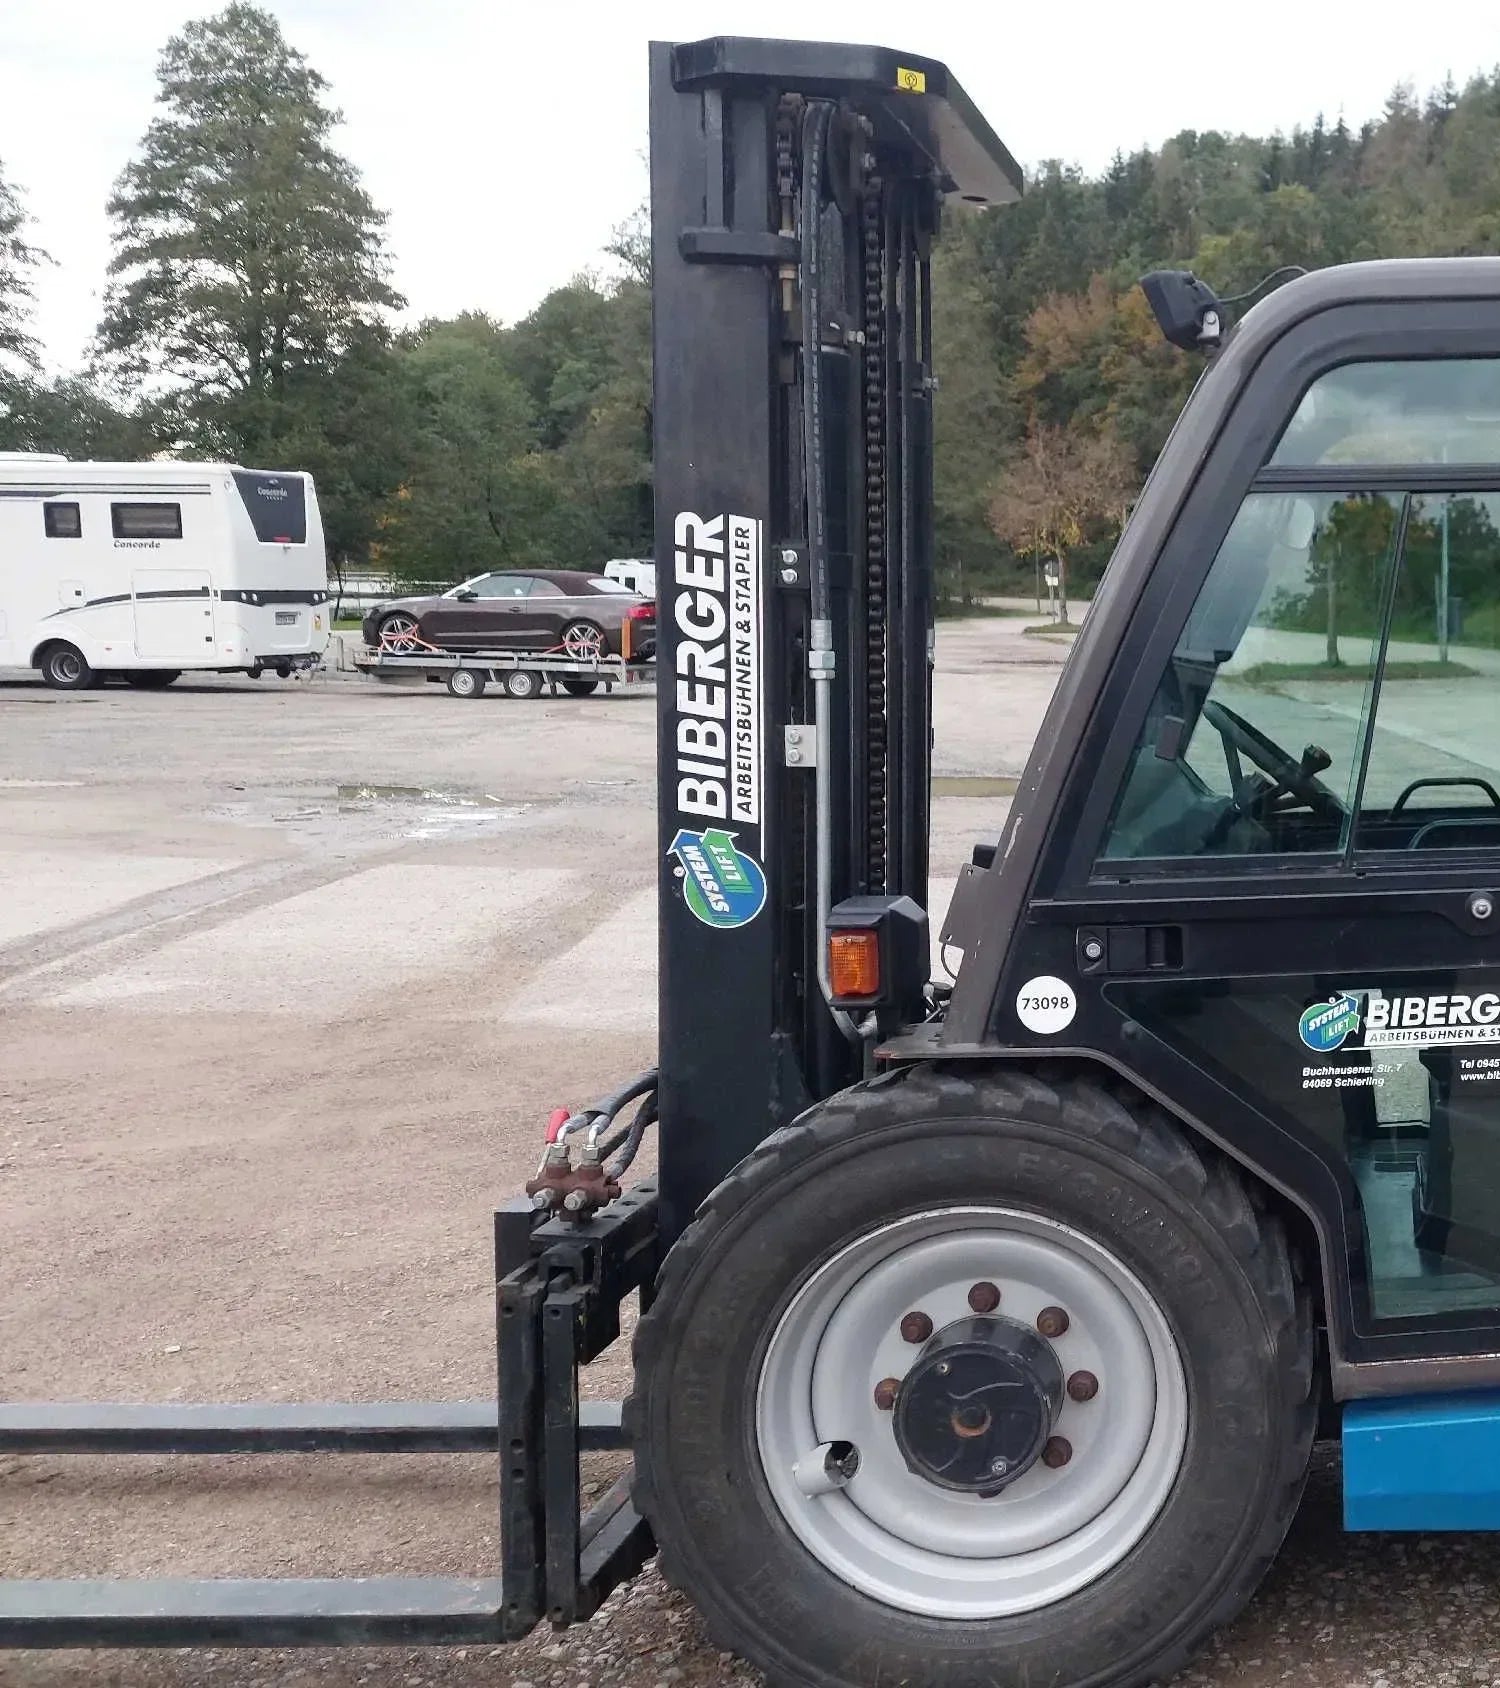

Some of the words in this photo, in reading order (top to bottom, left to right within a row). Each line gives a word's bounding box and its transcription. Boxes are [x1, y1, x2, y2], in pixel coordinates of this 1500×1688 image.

[113, 540, 161, 549] Concorde
[734, 526, 751, 613] STAPLER
[735, 620, 751, 634] &
[675, 511, 728, 819] BIBERGER
[735, 640, 752, 815] ARBEITSBÜHNEN
[709, 844, 742, 880] LIFT
[681, 845, 730, 912] SYSTEM
[1021, 996, 1069, 1010] 73098
[1308, 1001, 1350, 1031] SYSTEM
[1328, 1018, 1350, 1037] LIFT
[1369, 1029, 1474, 1042] ARBEITSBÜHNEN
[1478, 1028, 1487, 1038] &
[1302, 1066, 1374, 1076] Buchhausener
[1376, 1063, 1394, 1073] Str.
[1396, 1063, 1403, 1072] 7
[1460, 1059, 1475, 1069] Tel
[1302, 1079, 1333, 1089] 84069
[1334, 1077, 1385, 1087] Schierling
